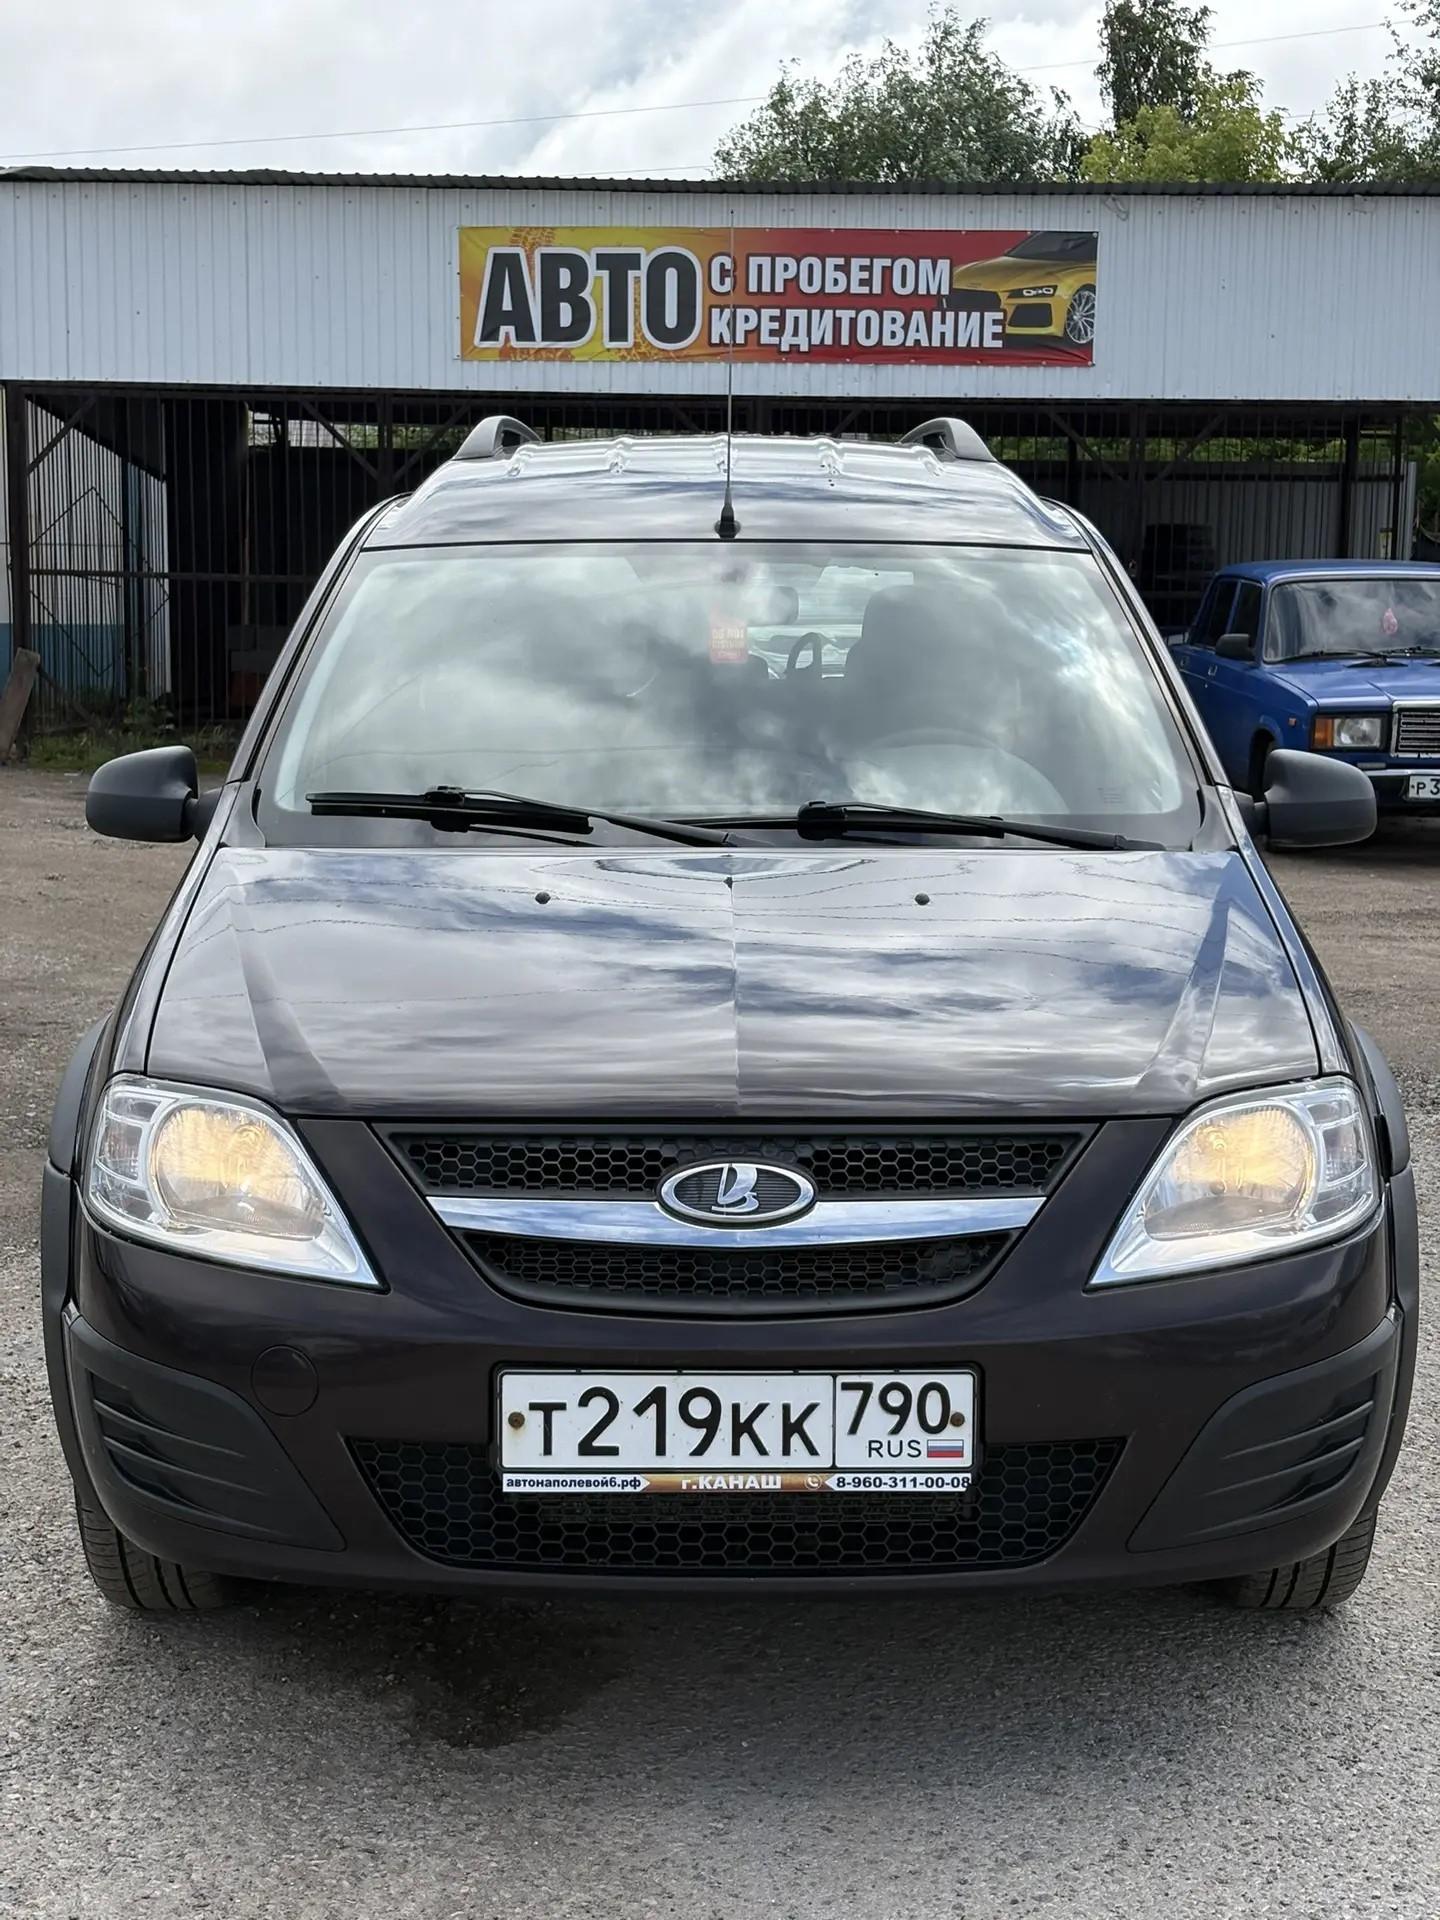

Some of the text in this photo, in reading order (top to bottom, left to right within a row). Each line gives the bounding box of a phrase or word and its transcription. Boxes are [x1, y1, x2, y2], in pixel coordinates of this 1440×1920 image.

[710, 255, 950, 296] С ПРОБЕГОМ
[477, 248, 702, 347] АВТО
[710, 308, 1004, 352] КРЕДИТОВАНИЕ
[840, 1381, 952, 1436] 790
[867, 1439, 922, 1458] RUS
[681, 1474, 783, 1490] г.КАНАШ
[836, 1475, 972, 1489] 8-960-311-00-08
